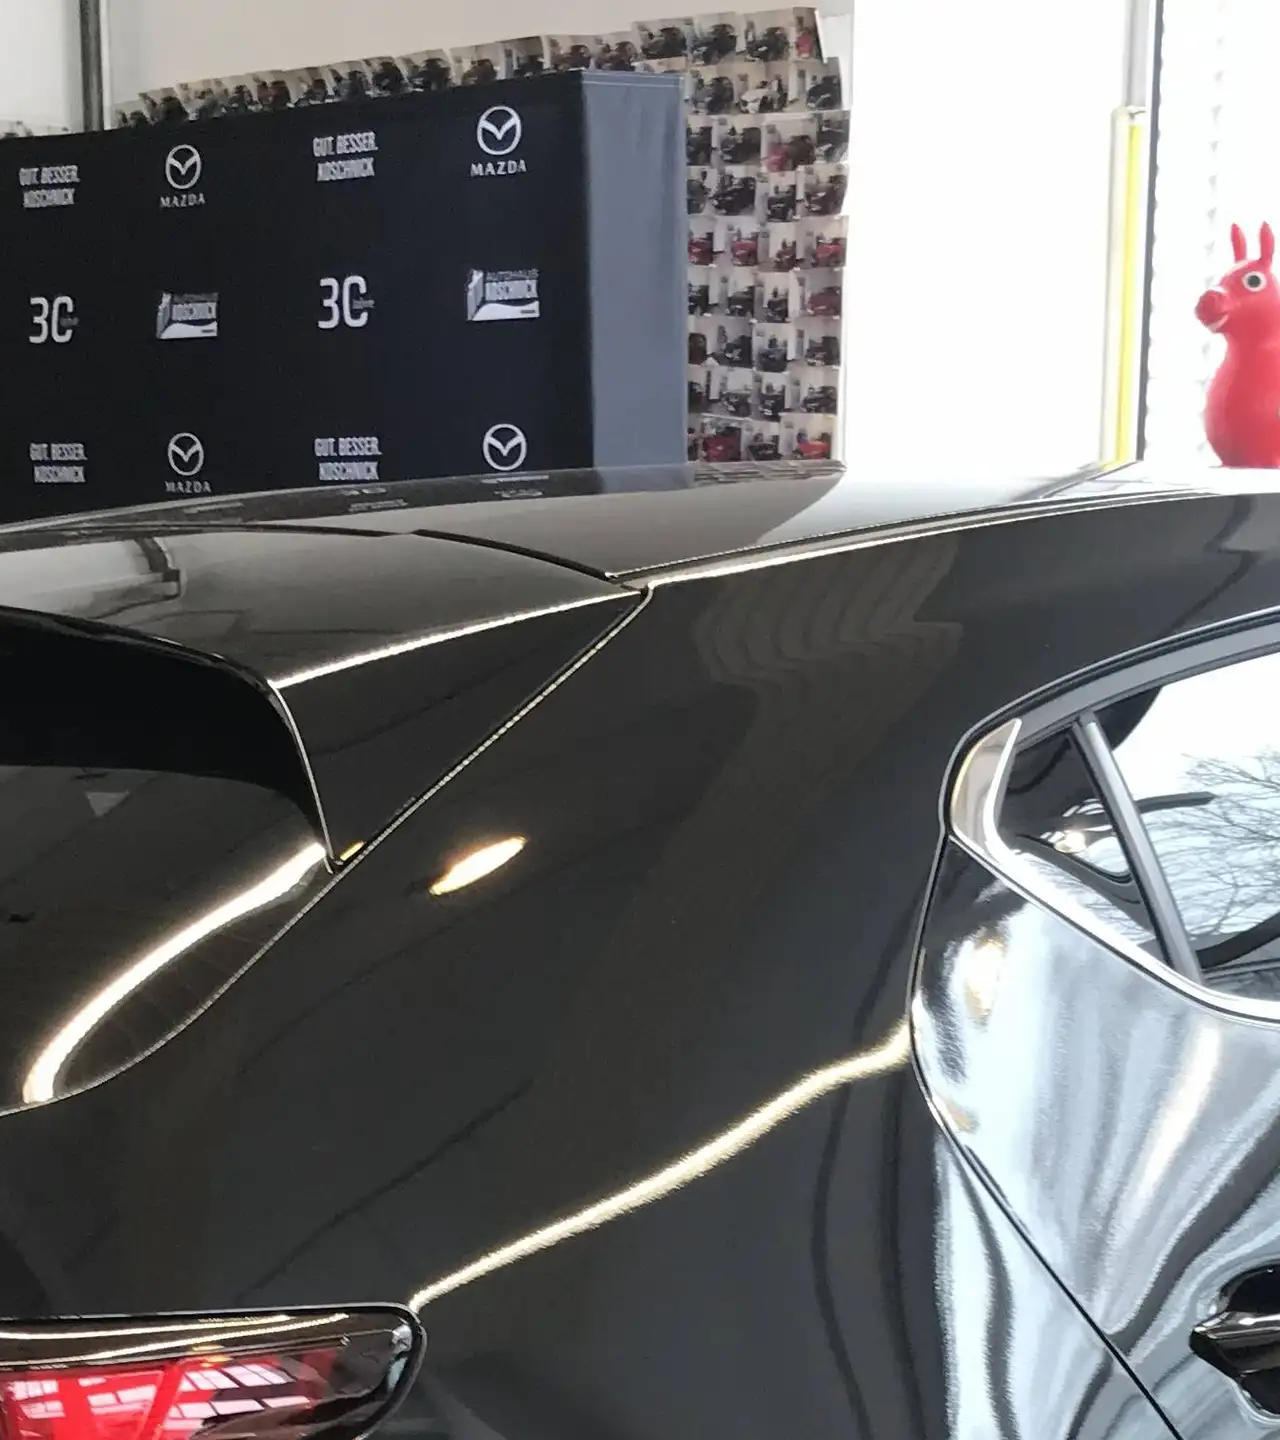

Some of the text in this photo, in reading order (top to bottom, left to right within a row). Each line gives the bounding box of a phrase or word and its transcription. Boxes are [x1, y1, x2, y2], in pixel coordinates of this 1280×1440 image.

[471, 160, 526, 176] MAZDA
[160, 192, 206, 208] MAZDA
[318, 275, 369, 329] 3C
[28, 296, 74, 344] 3C
[165, 480, 212, 494] MAZDA
